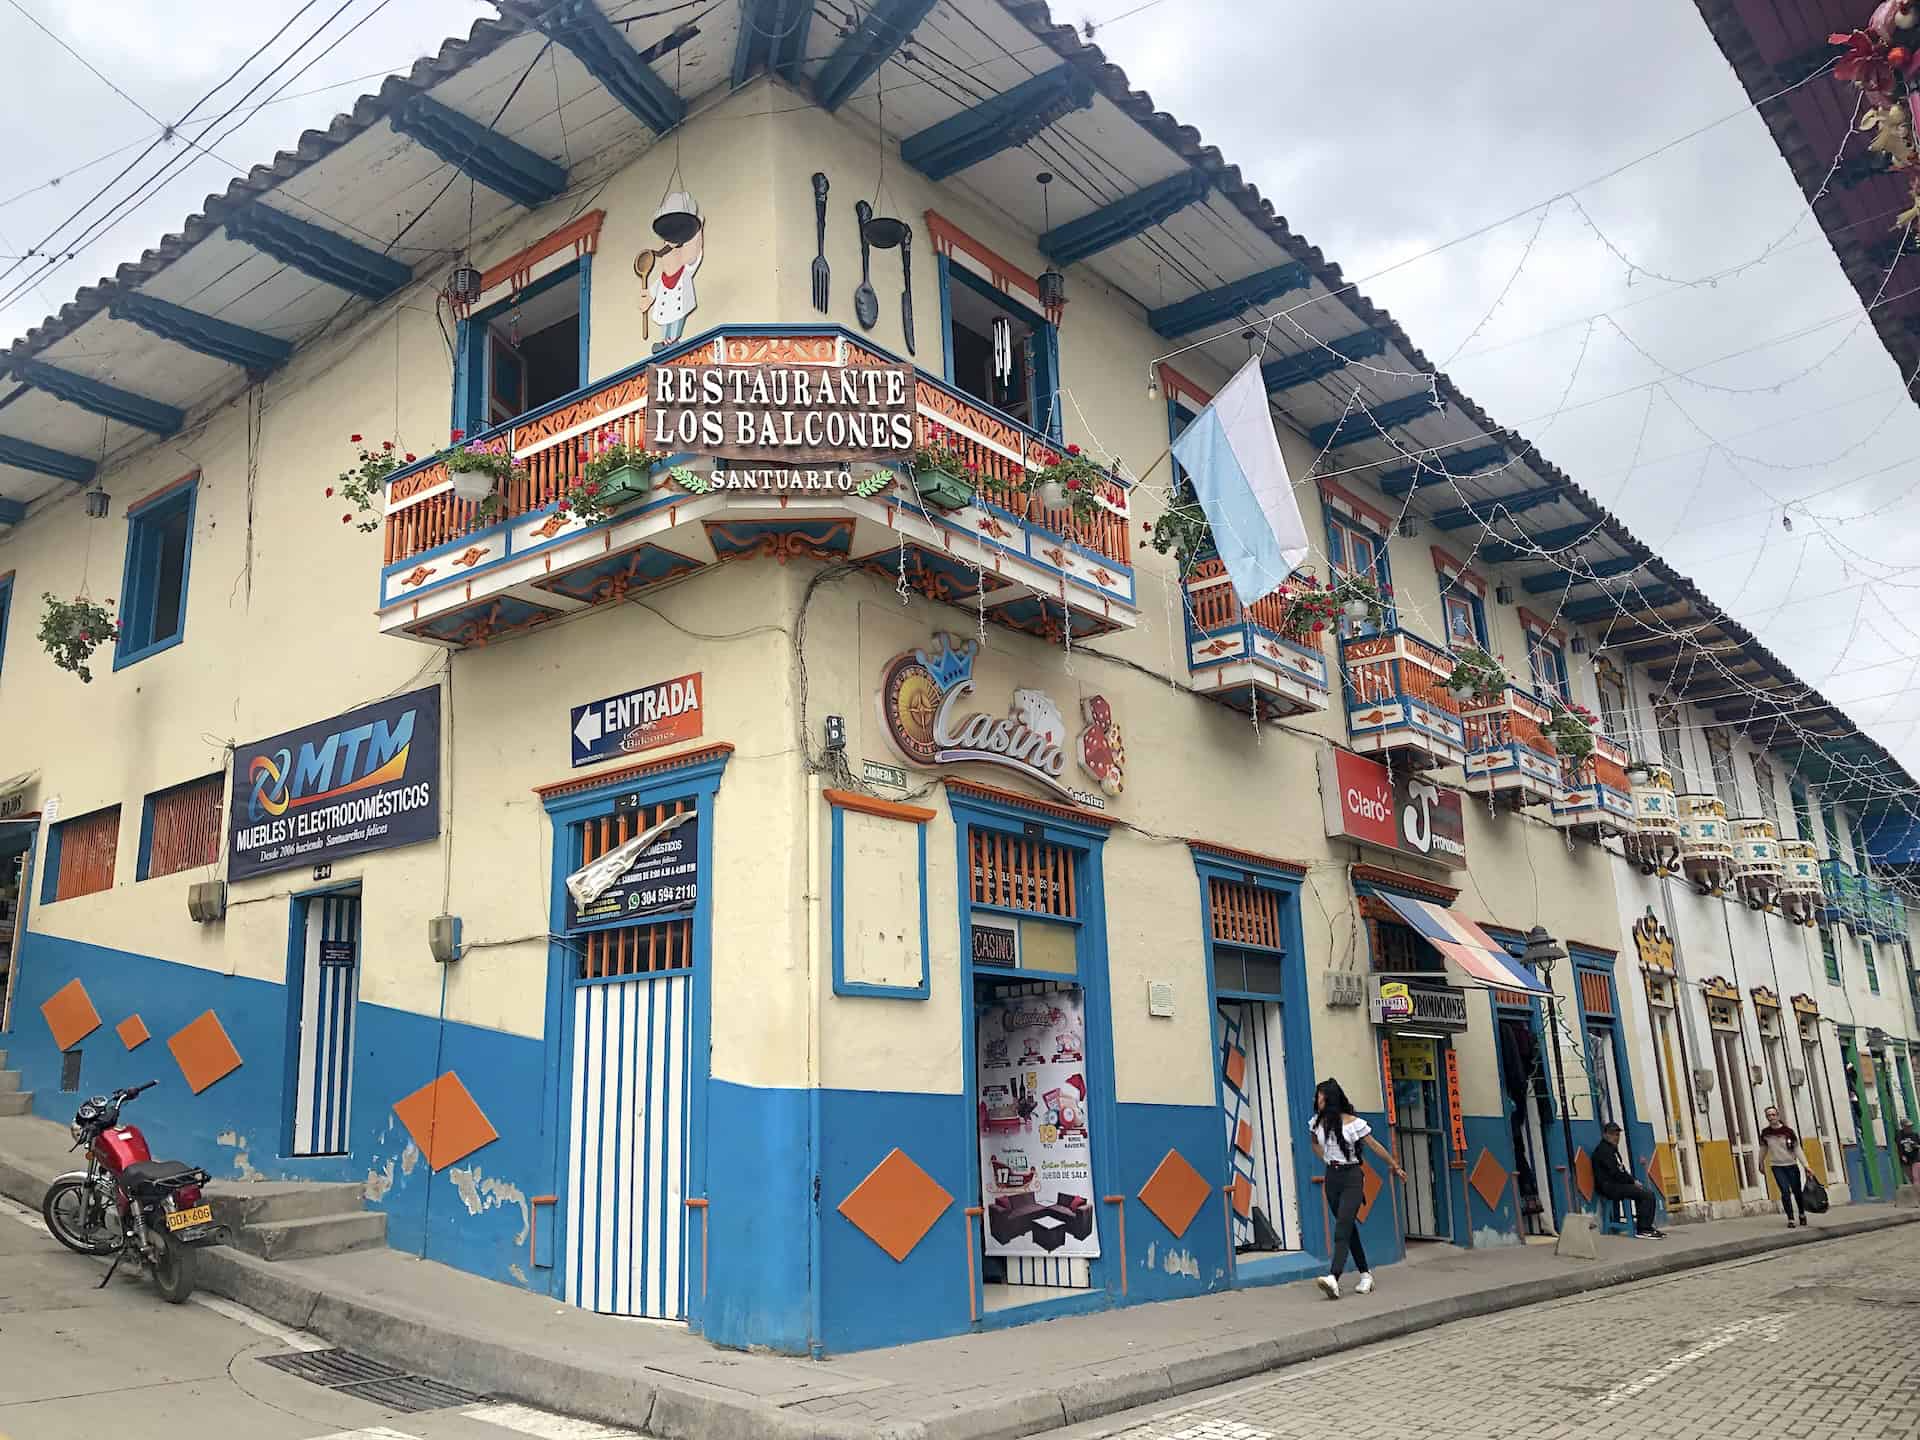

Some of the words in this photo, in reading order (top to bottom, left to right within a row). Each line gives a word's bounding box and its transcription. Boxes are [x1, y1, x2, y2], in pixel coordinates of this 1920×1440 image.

[655, 367, 905, 407] RESTAURANTE
[654, 409, 723, 445] LOS
[736, 411, 913, 450] BALCONES
[710, 470, 852, 490] SANTUARIO
[605, 679, 698, 733] ENTRADA
[933, 679, 1065, 776] Casino
[291, 709, 417, 797] MTM
[236, 819, 286, 852] MUEBLES
[287, 817, 296, 839] Y
[298, 782, 429, 837] ELECTRODOMÉSTICOS
[1347, 788, 1385, 822] Claro
[1403, 780, 1439, 853] J
[259, 847, 279, 862] Desde
[295, 836, 324, 854] haciendo
[365, 823, 388, 841] felices
[641, 891, 656, 905] 304
[658, 888, 673, 902] 594
[675, 884, 696, 899] 2110
[975, 933, 1013, 960] CASINO
